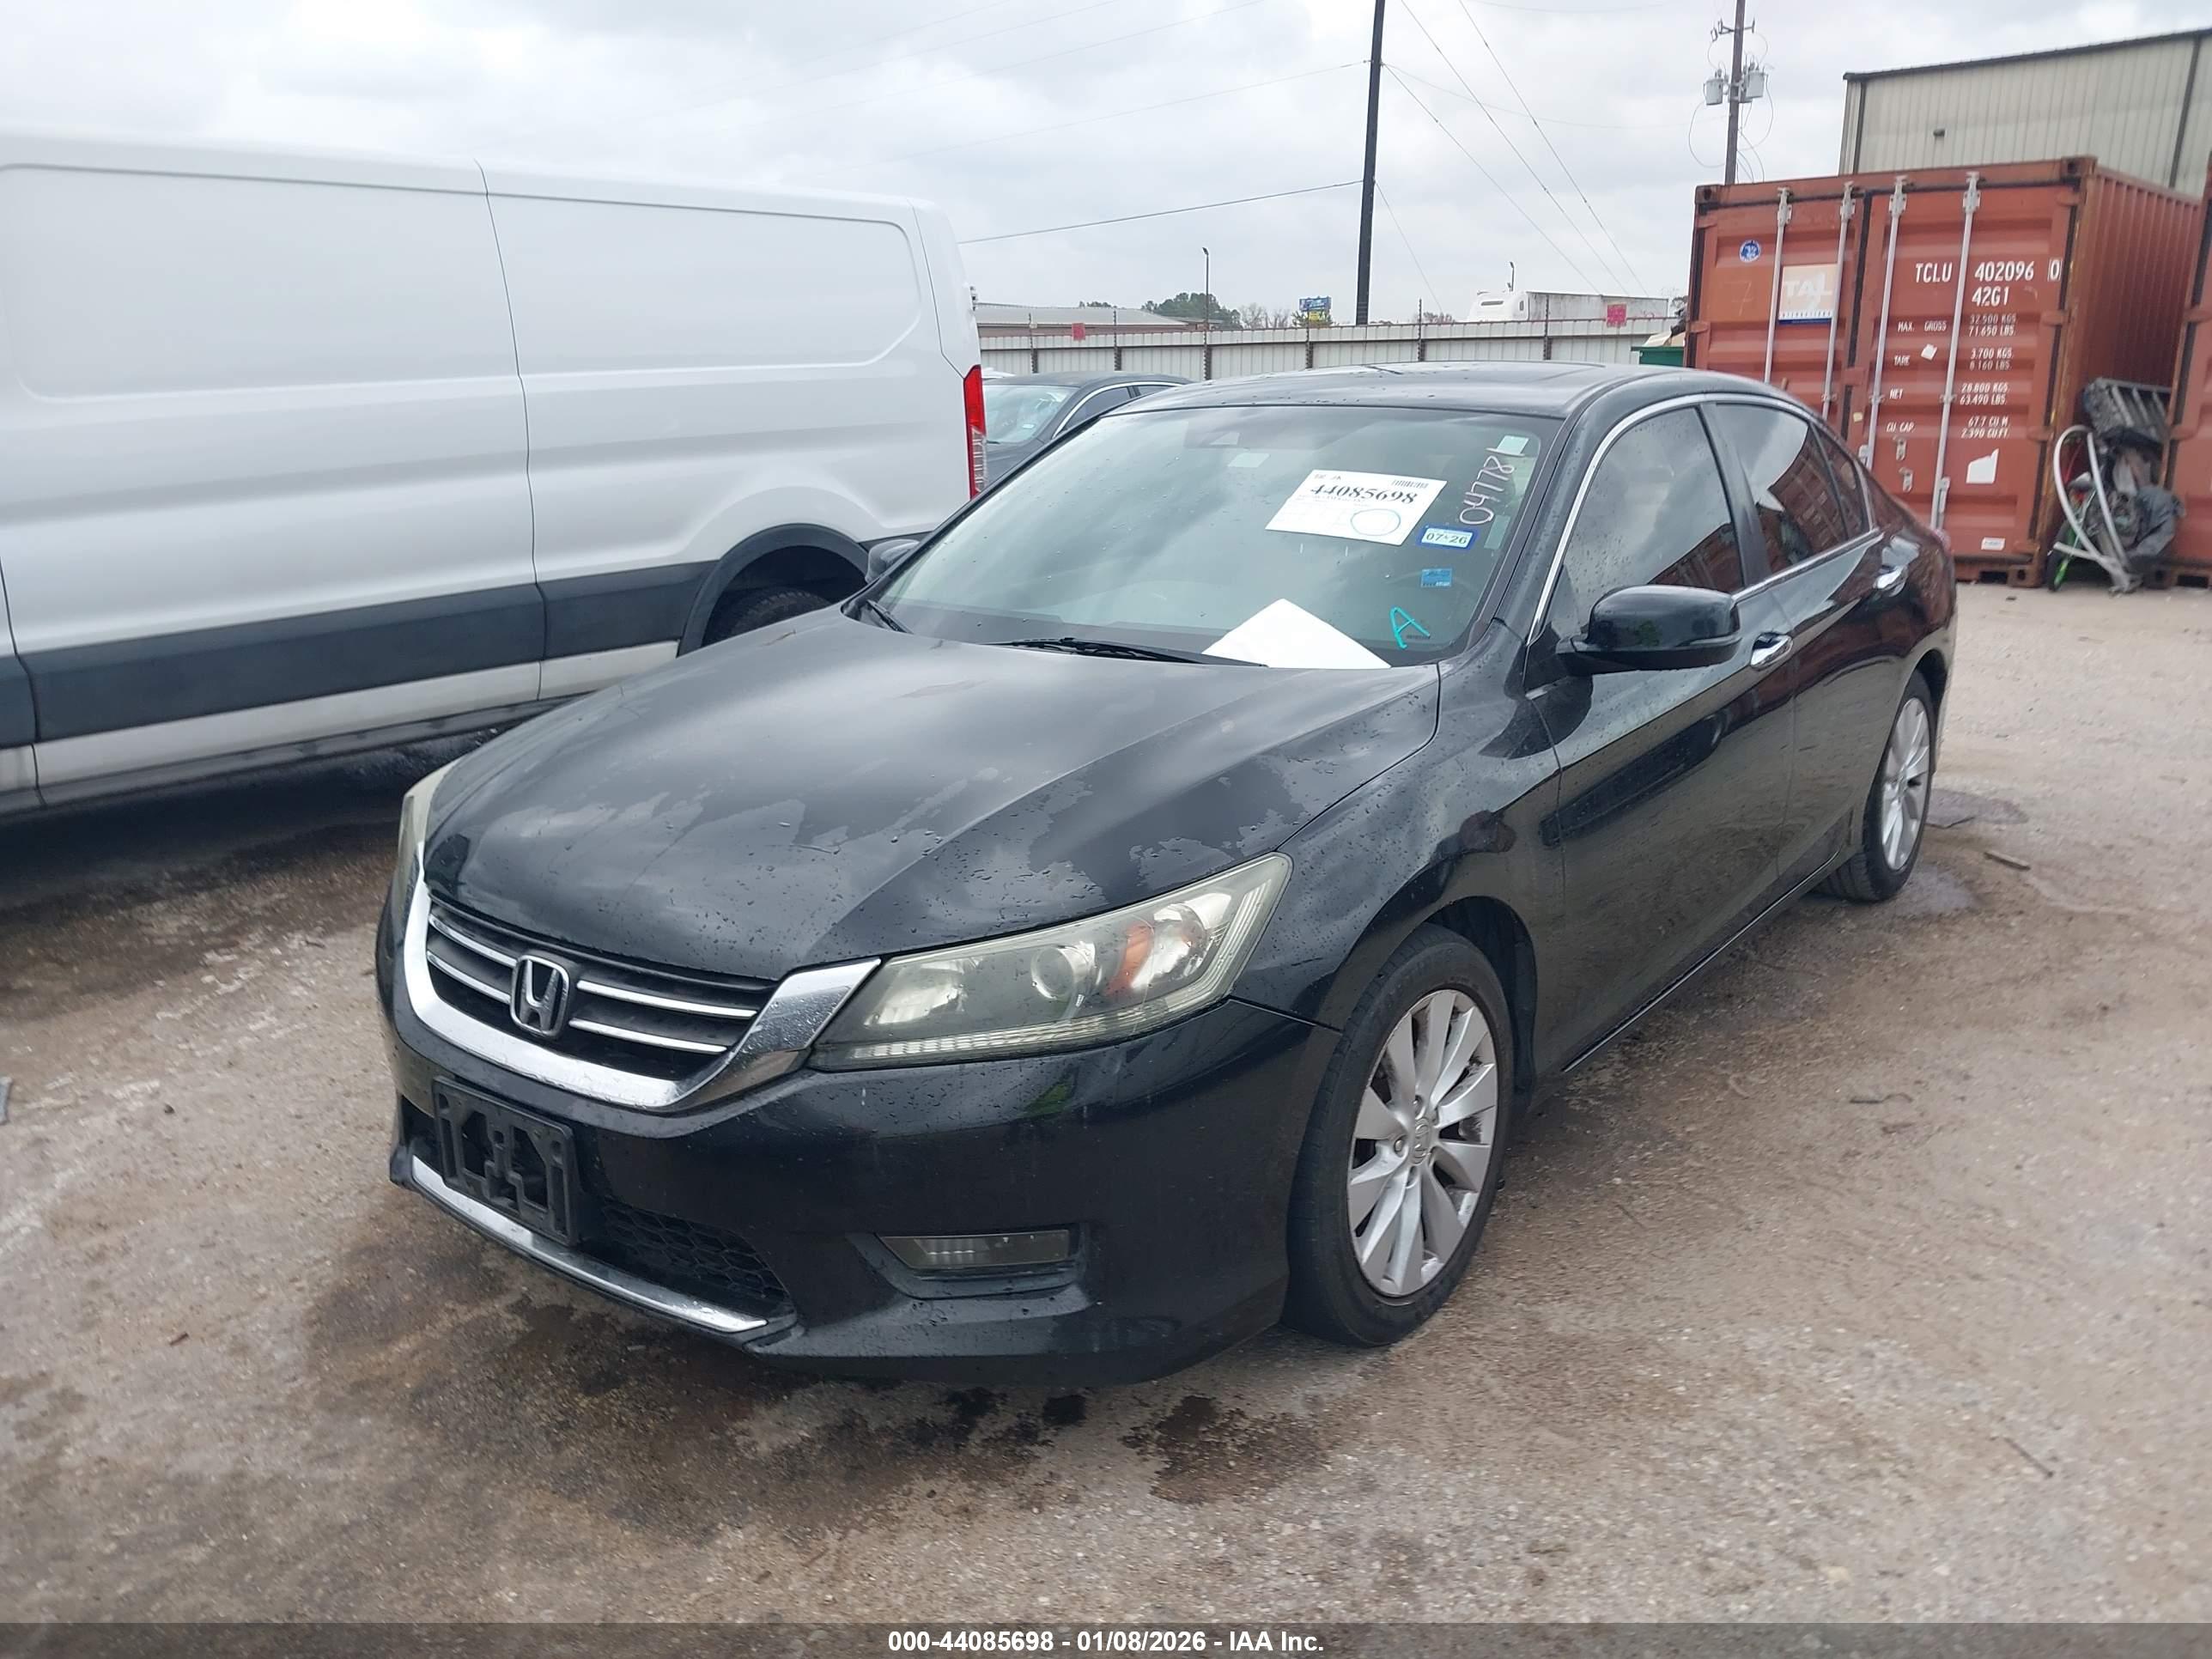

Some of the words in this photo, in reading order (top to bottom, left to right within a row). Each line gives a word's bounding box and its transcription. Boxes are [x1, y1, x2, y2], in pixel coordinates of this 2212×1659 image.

[1916, 262, 1953, 283] TCLU
[1974, 260, 2035, 282] 402096
[2049, 259, 2061, 282] 0
[1972, 286, 2009, 307] 42G1
[1924, 320, 1947, 332] GROSS
[1971, 347, 1995, 359] 3.700
[1889, 388, 1903, 399] NET
[1310, 483, 1418, 504] 44085698
[1389, 606, 1431, 648] A
